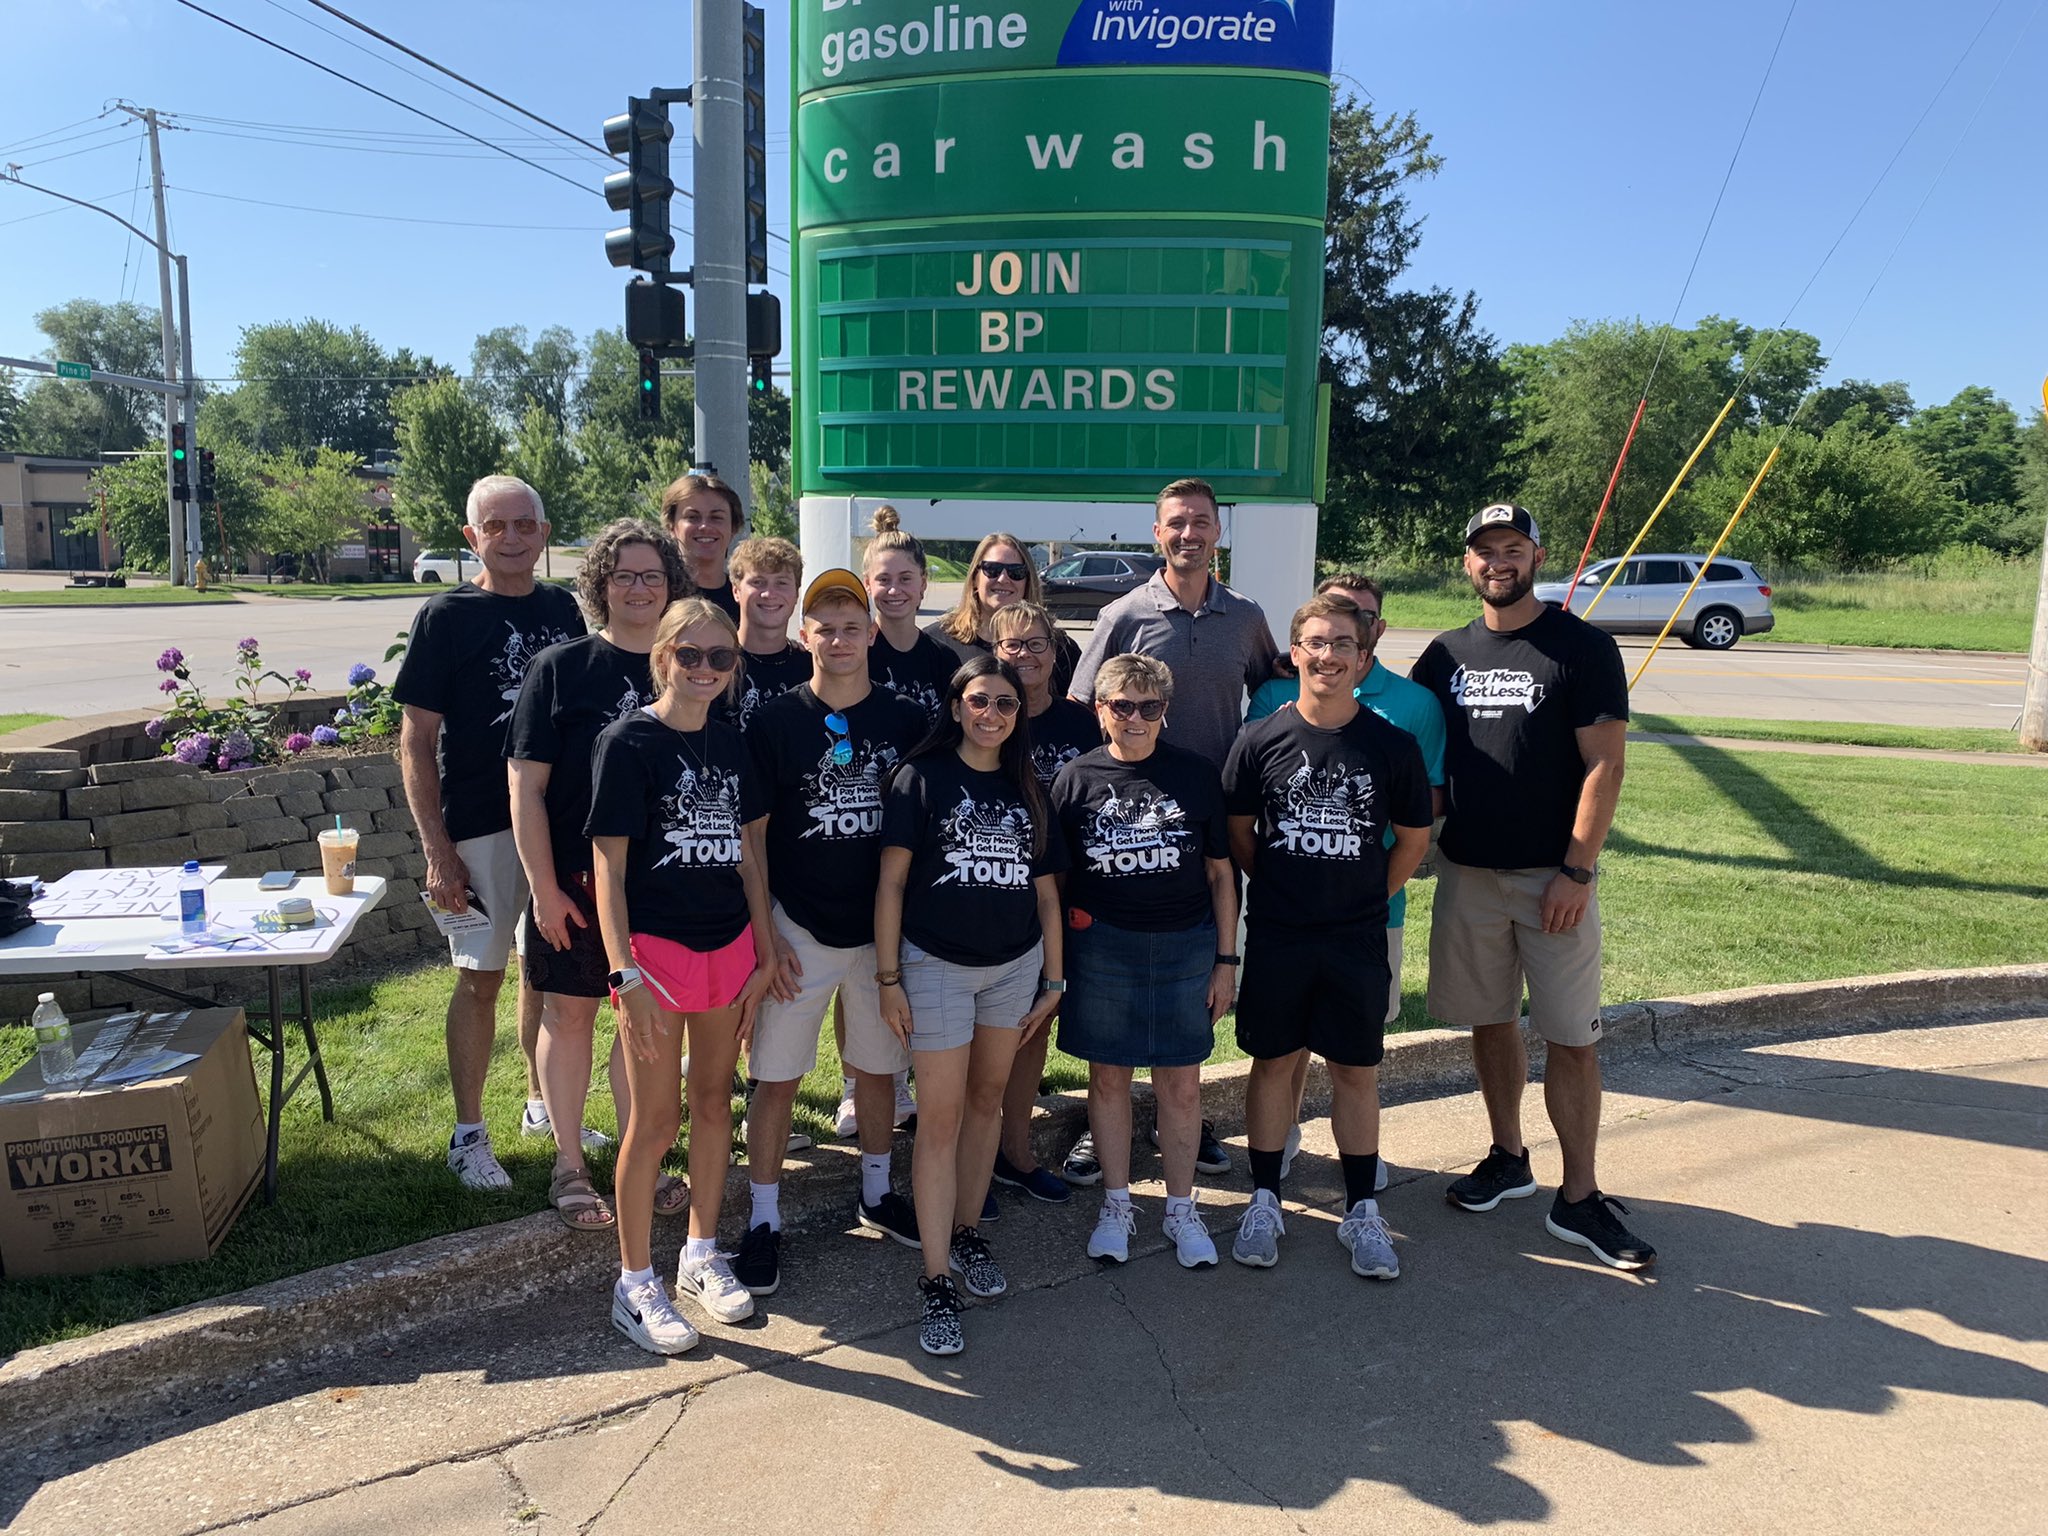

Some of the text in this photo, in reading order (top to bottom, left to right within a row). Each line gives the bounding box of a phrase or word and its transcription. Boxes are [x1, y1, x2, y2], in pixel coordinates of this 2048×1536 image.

[1108, 0, 1143, 11] with
[1092, 8, 1276, 48] Invigorate
[821, 4, 1028, 77] gasoline
[823, 120, 1287, 184] car wash
[956, 251, 1080, 296] JOIN
[979, 311, 1044, 353] BP
[60, 364, 78, 375] Pine
[899, 368, 1176, 411] REWARDS
[1465, 671, 1531, 685] Pay More.
[1463, 686, 1528, 698] Get Less.
[840, 788, 856, 796] Pay
[840, 796, 857, 804] Get
[698, 812, 711, 821] Pay
[1306, 807, 1348, 817] Pay More.
[699, 821, 712, 830] Get
[819, 810, 883, 836] TOU
[1305, 815, 1347, 825] Get Less.
[976, 835, 1017, 845] Pay More.
[1116, 837, 1134, 845] Get
[1285, 829, 1361, 857] TOUR
[676, 839, 742, 863] TOUR
[976, 845, 1016, 854] Get Less.
[1095, 846, 1180, 873] TOUR
[955, 860, 1030, 885] TOUR
[32, 902, 172, 915] NEED
[7, 1126, 166, 1157] PROMOTIONAL PRODUCTS
[16, 1143, 162, 1186] WORK!
